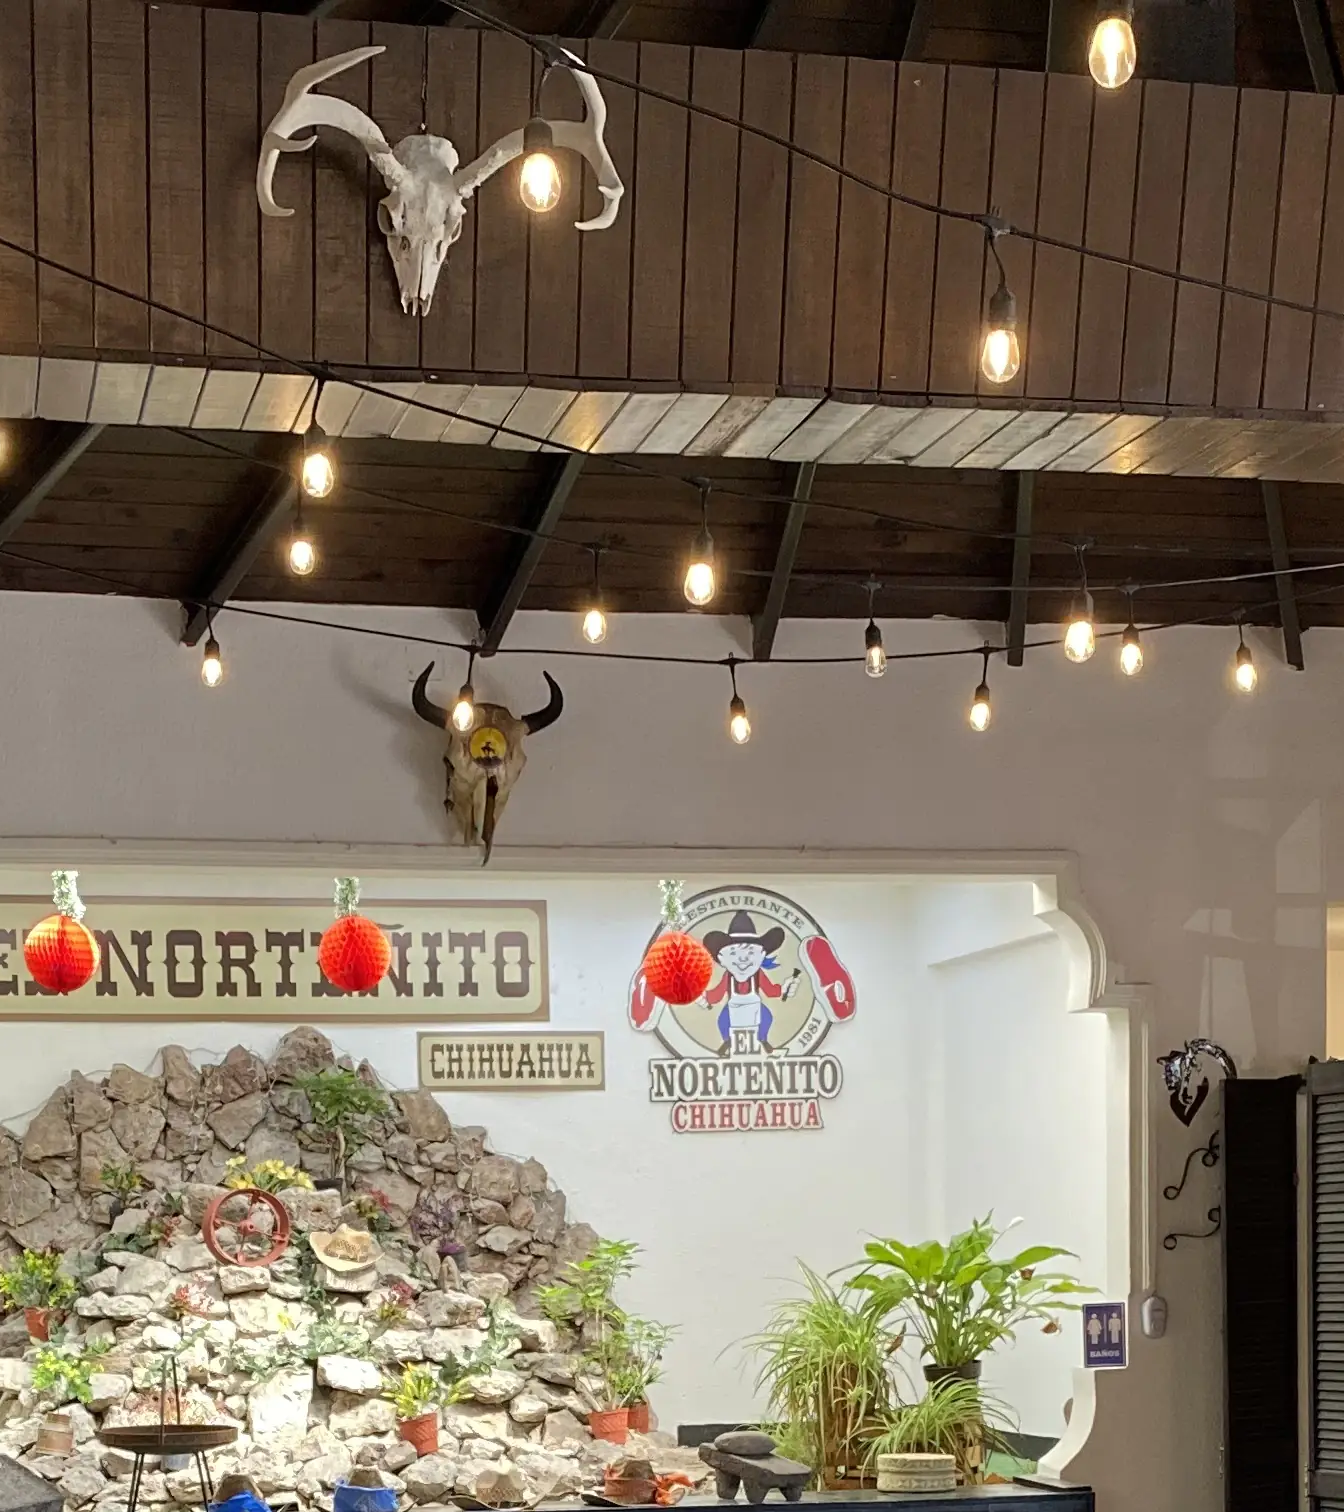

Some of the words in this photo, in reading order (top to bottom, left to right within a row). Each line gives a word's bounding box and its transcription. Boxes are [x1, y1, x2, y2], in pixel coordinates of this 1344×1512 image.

[93, 923, 535, 999] NORTÑITO
[732, 1029, 761, 1055] EL
[797, 1016, 823, 1048] 1981
[429, 1041, 597, 1081] CHIHUAHUA
[653, 1055, 839, 1098] NORTEÑITO
[672, 1101, 821, 1129] CHIHUAHUA
[1089, 1349, 1120, 1358] BAÑOS
